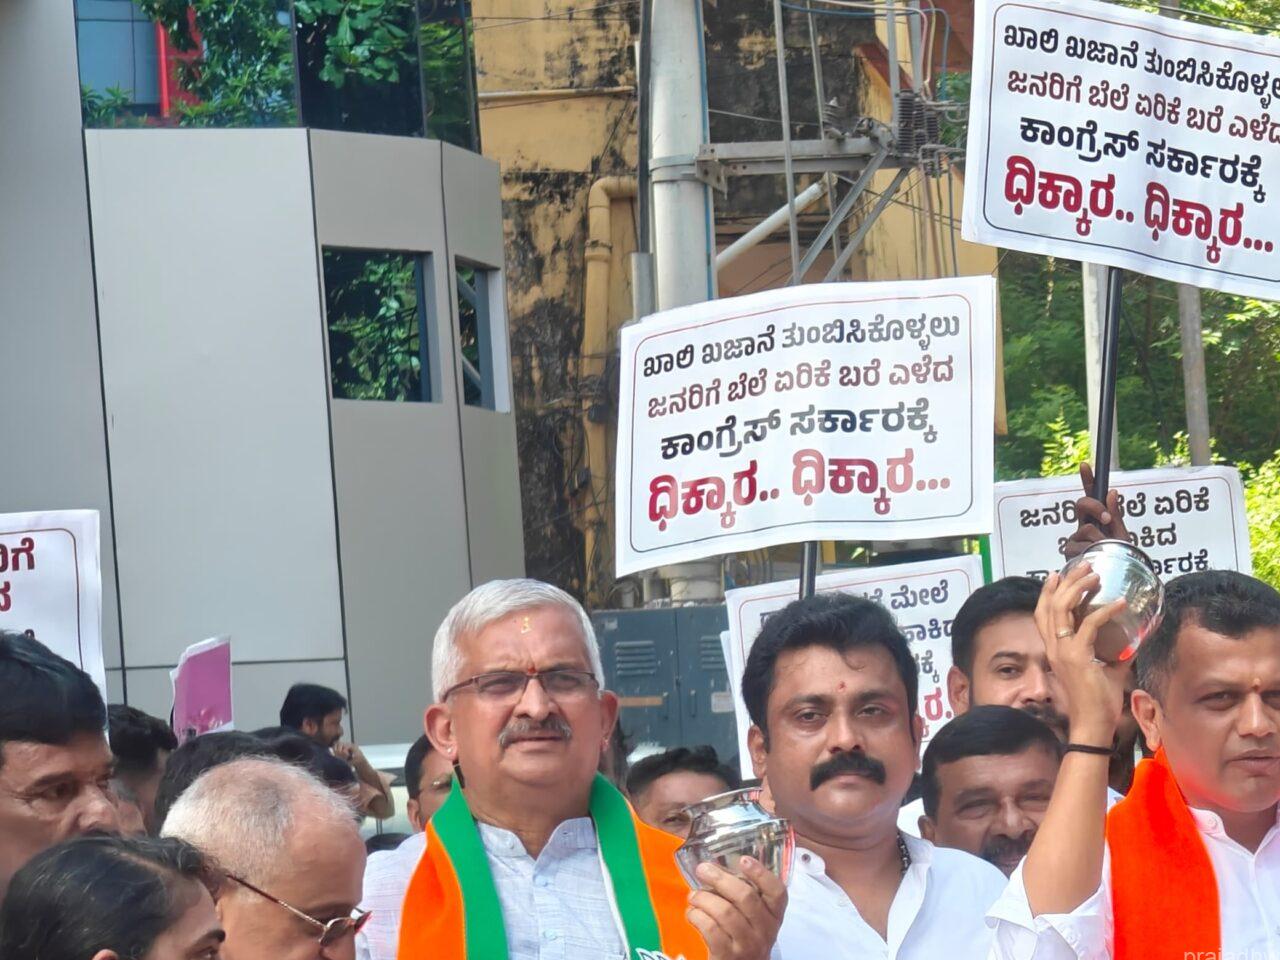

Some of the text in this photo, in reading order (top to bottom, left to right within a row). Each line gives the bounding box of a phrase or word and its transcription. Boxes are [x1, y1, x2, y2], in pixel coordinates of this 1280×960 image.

[1003, 23, 1059, 54] ಖಾಲಿ
[1065, 34, 1140, 70] ಖಜಾನೆ
[1006, 68, 1083, 103] ಜನರಿಗೆ
[1089, 82, 1130, 112] ಬೆಲೆ
[1135, 91, 1181, 125] ಏರಿಕೆ
[1186, 105, 1224, 134] ಬರೆ
[1019, 115, 1267, 204] ಕಾಂಗ್ರೆಸ್ ಸರ್ಕಾರಕ್ಕೆ
[1003, 155, 1275, 264] ಧಿಕ್ಕಾರ.. ಧಿಕ್ಕಾರ...
[643, 312, 961, 378] ಖಾಲಿ ಖಜಾನೆ ತುಂಬಿಸಿಕೊಳ್ಳಲು
[647, 355, 955, 420] ಜನರಿಗೆ ಬೆಲೆ ಏರಿಕೆ ಬರೆ ಎಳೆದ
[660, 397, 939, 460] ಕಾಂಗ್ರೆಸ್ ಸರ್ಕಾರಕ್ಕೆ
[647, 447, 951, 532] ಧಿಕ್ಕಾರ.. ಧಿಕ್ಕಾರ...
[1019, 500, 1077, 528] ಜನರಿ
[1154, 486, 1210, 516] ಏರಿಕೆ
[890, 579, 949, 610] ಮೇಲೆ
